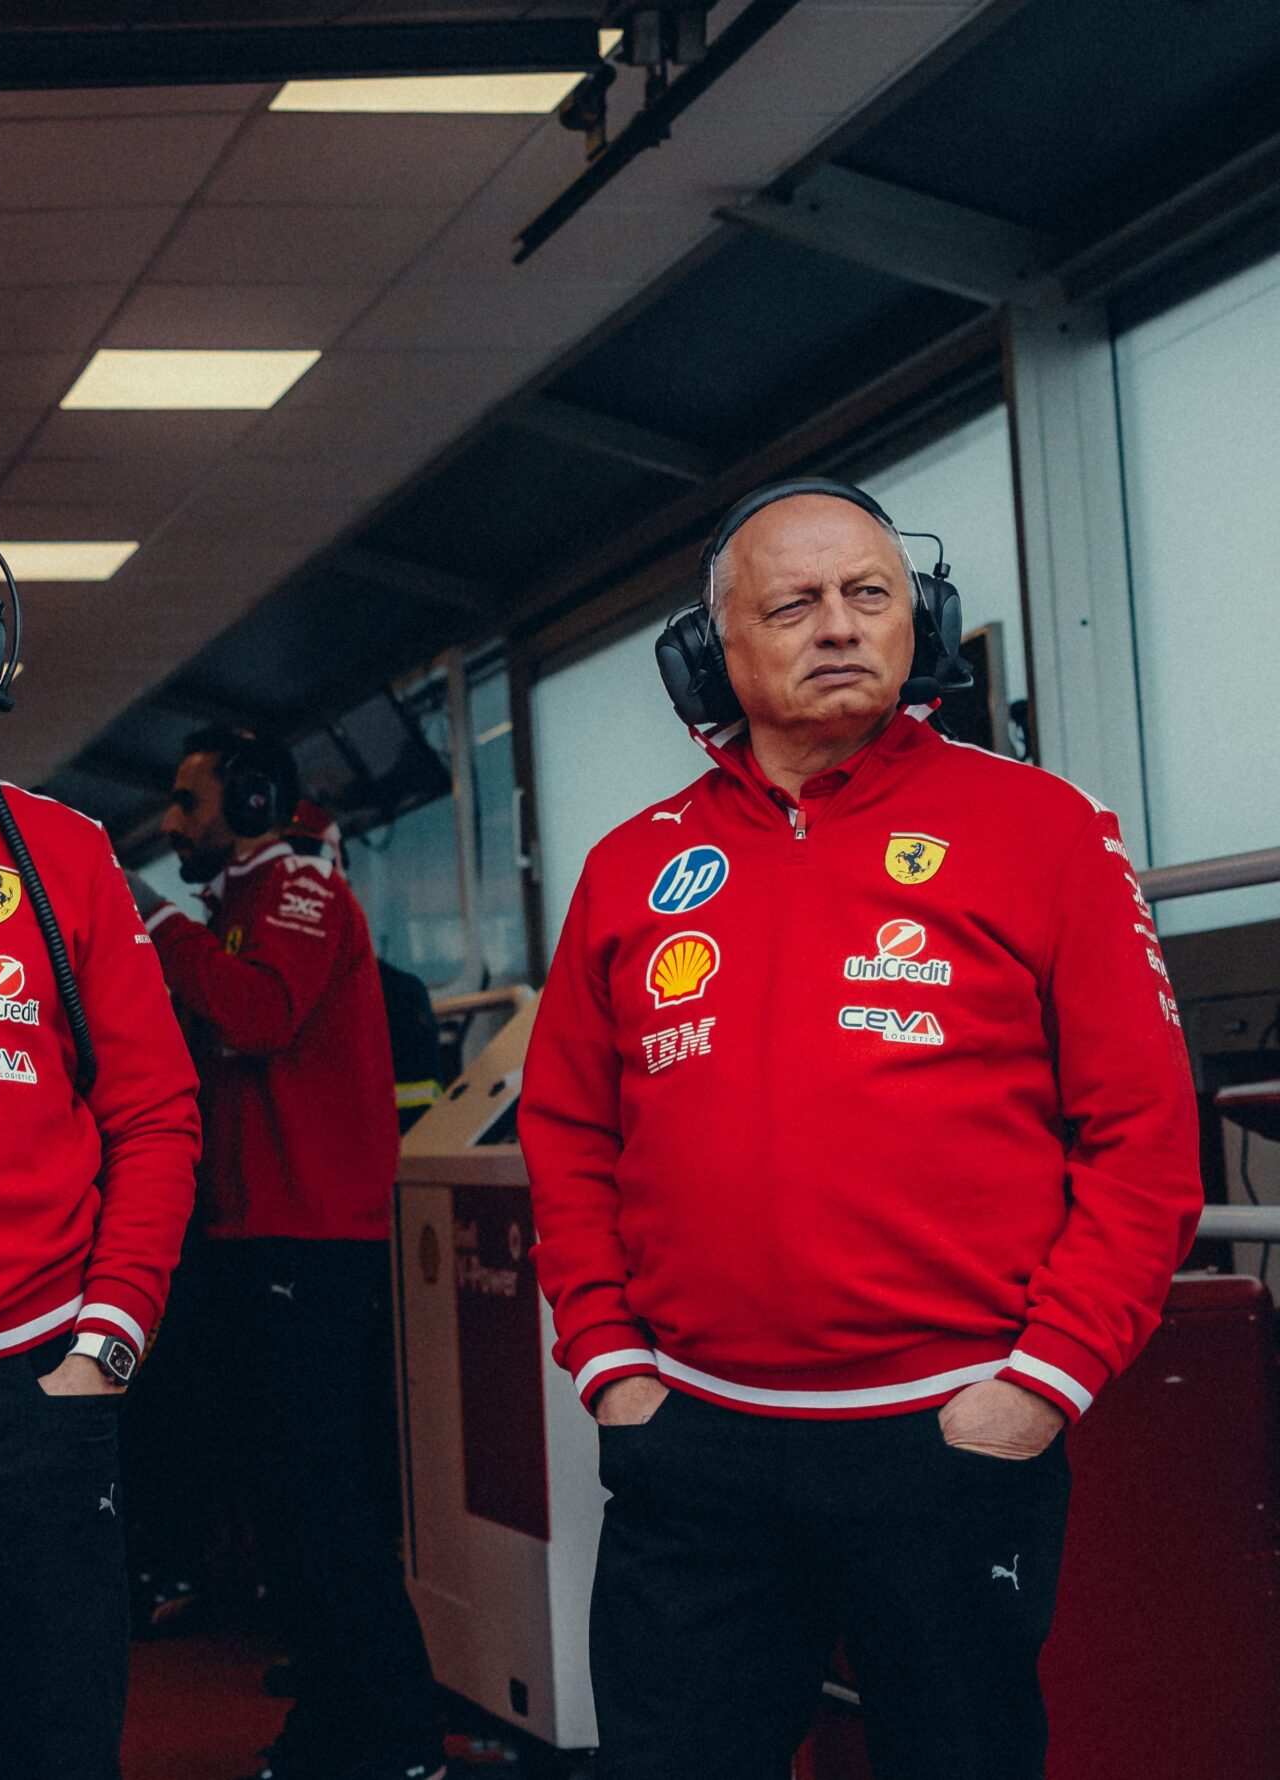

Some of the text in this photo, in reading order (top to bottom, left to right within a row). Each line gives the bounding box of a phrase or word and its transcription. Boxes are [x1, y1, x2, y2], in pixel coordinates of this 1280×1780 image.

[659, 850, 719, 912] hp
[846, 956, 950, 984] UniCredit
[642, 1017, 716, 1075] IBM
[885, 1033, 942, 1044] LOGISTICS
[0, 1072, 37, 1083] LOGISTICS
